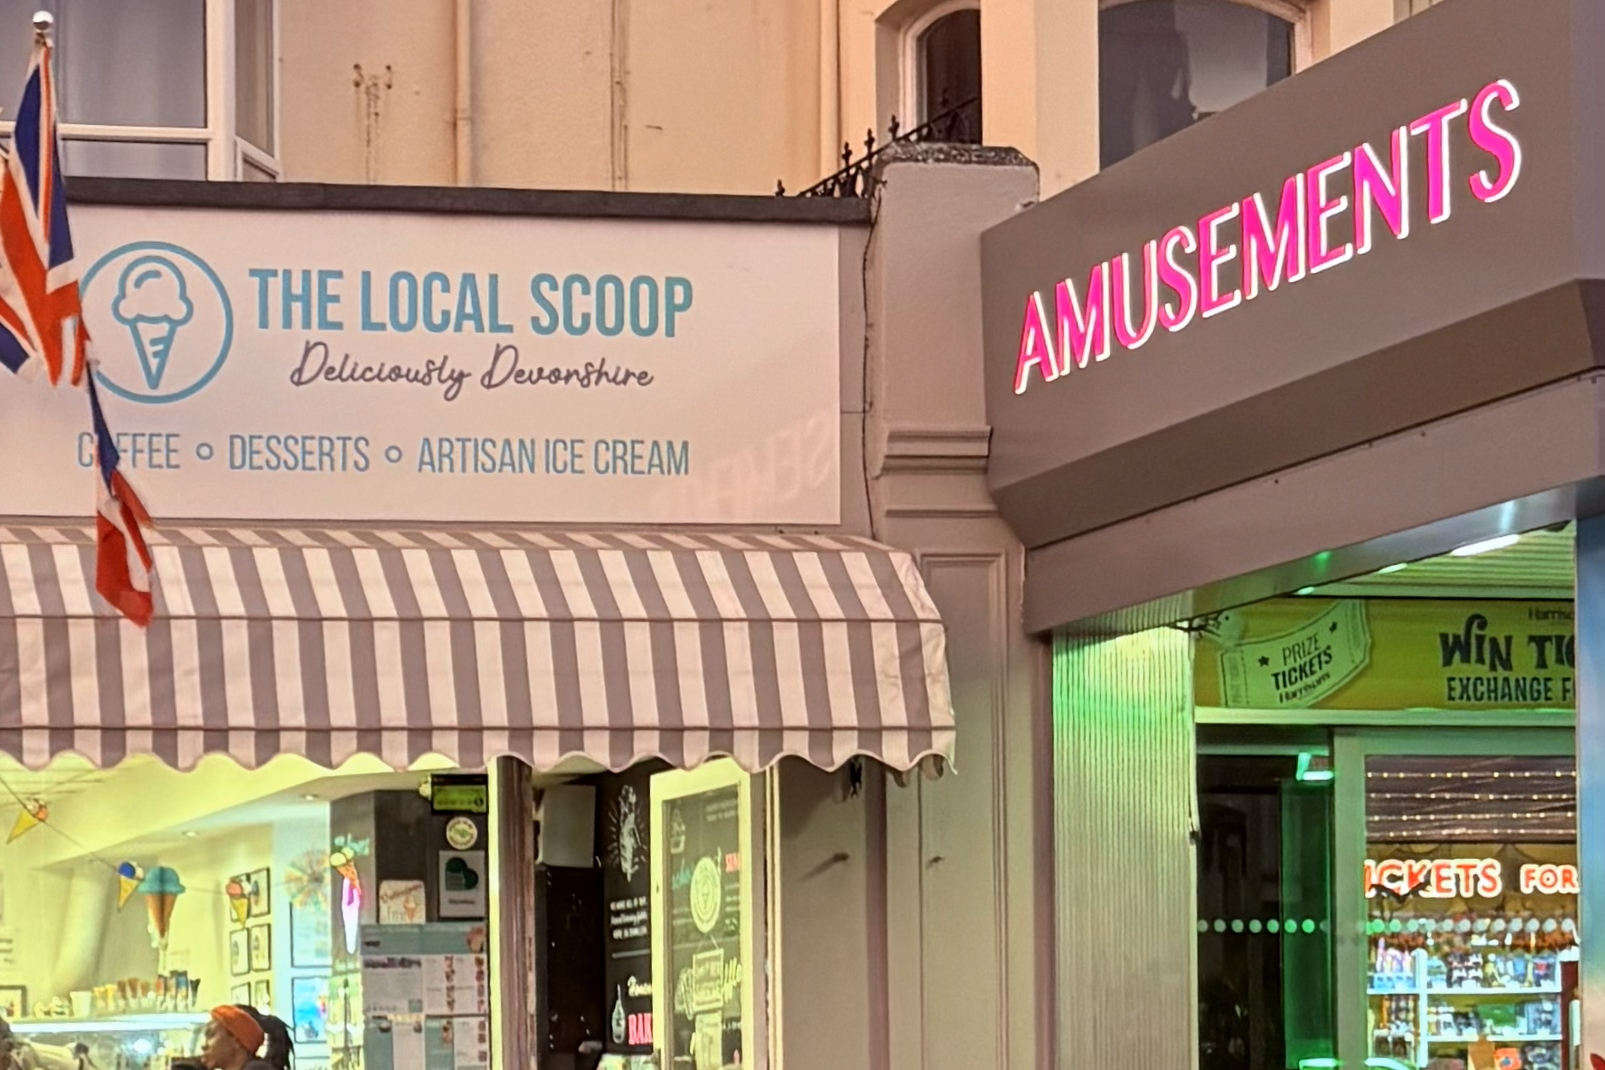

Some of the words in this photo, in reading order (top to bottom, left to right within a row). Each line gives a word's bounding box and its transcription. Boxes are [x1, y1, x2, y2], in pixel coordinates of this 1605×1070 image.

[1014, 79, 1521, 394] AMUSEMENTS
[248, 268, 344, 330] THE
[360, 270, 514, 334] LOCAL
[530, 273, 693, 338] SCOOP
[289, 341, 471, 402] Deliciously
[480, 344, 654, 390] Devonshire
[77, 432, 181, 470] CFFEE
[229, 435, 370, 472] DESSERTS
[417, 437, 537, 475] ARTISAN
[544, 440, 585, 475] ICE
[593, 440, 690, 477] CREAM
[1271, 644, 1333, 691] TICKETS
[1282, 633, 1320, 666] PRIZE
[1446, 676, 1553, 702] EXCHANGE
[1520, 864, 1579, 894] FOR
